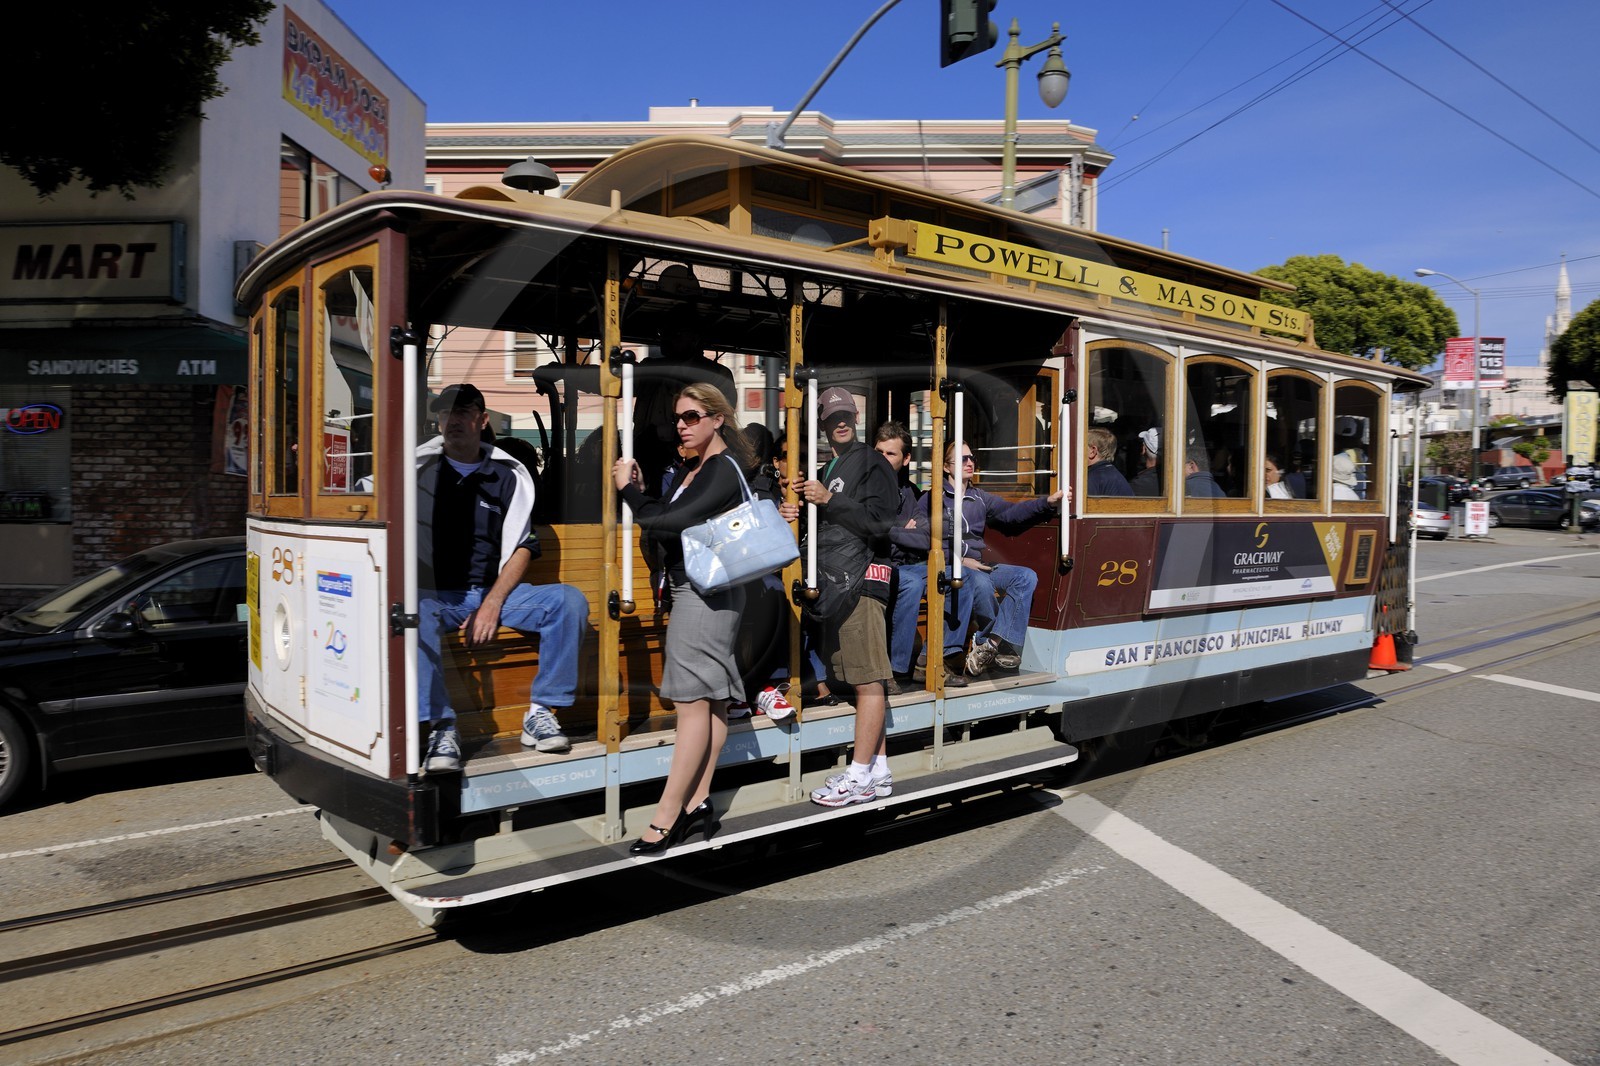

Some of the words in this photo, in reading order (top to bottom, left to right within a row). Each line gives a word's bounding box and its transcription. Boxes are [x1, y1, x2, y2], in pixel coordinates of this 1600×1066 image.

[12, 243, 157, 280] MART
[933, 232, 1100, 288] POWELL
[1118, 275, 1139, 297] &
[1156, 283, 1258, 321] MASON
[1267, 309, 1301, 330] Sts.
[795, 330, 801, 344] ON
[27, 358, 140, 376] SANDWICHES
[176, 359, 217, 376] ATM
[5, 408, 61, 430] OPEN
[272, 546, 295, 585] 28
[1233, 551, 1285, 566] GRACEWAY
[1097, 559, 1139, 587] 28
[1232, 566, 1279, 575] PHARMACEUTICALS
[1104, 646, 1139, 666] SAN
[1144, 634, 1225, 661] FRANCISCO
[1301, 619, 1344, 638] RAILWAY
[967, 702, 982, 711] TWO
[983, 696, 1016, 708] STANDEES
[1017, 694, 1034, 703] ONLY
[827, 725, 846, 736] TWO
[735, 740, 759, 752] ONLY
[472, 784, 502, 797] TWO
[505, 773, 567, 792] STANDEES
[569, 768, 598, 781] ONLY
